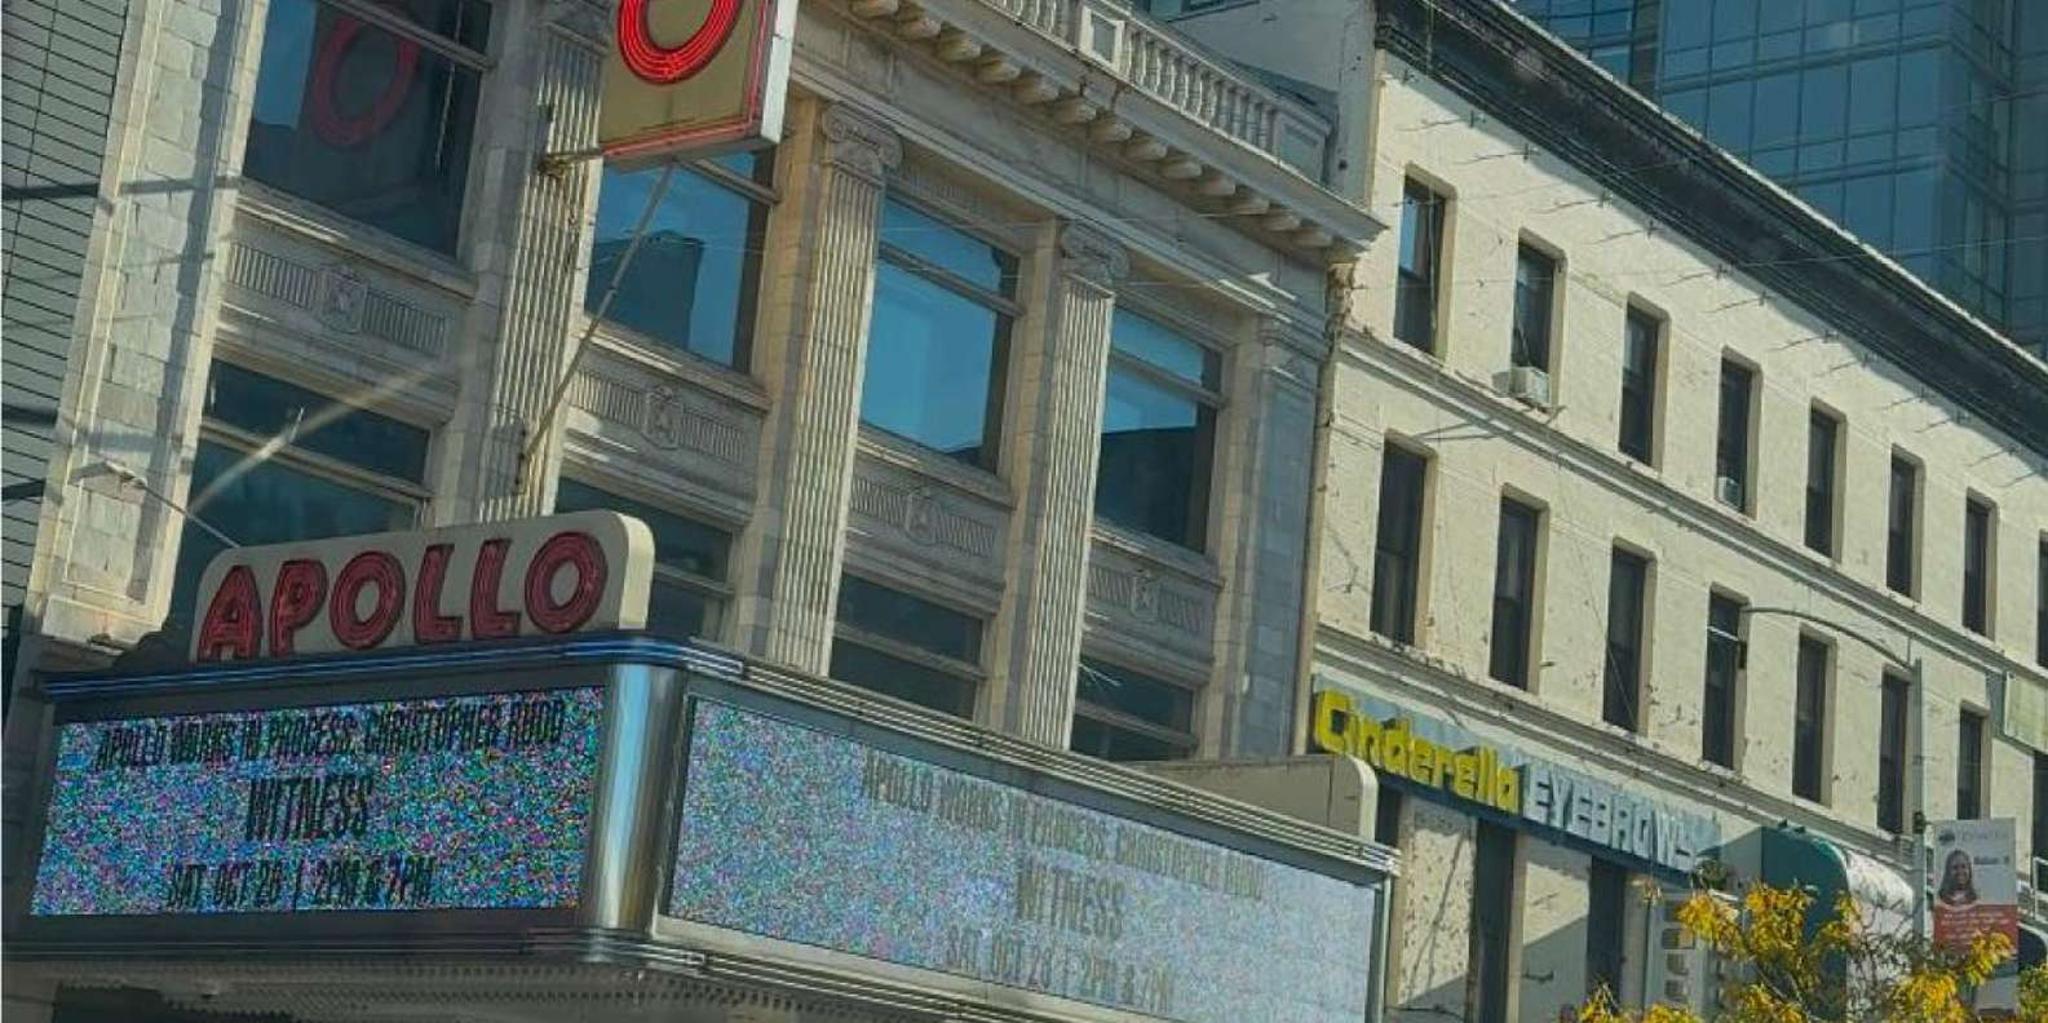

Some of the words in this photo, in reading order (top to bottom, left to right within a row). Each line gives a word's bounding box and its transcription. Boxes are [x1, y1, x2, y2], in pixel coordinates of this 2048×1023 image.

[197, 530, 608, 662] APOLLO
[95, 723, 167, 771] APOLLO
[170, 720, 236, 765] WORKS
[239, 717, 264, 761] IN
[363, 704, 504, 755] CHRISTOPHER
[1314, 688, 1520, 815] Cinderella
[245, 773, 374, 842] WITNESS
[860, 750, 933, 813] APOLLO
[937, 772, 1004, 832] WORKS
[1007, 791, 1030, 842] IN
[167, 864, 209, 907] SAT
[212, 862, 253, 907] OCT
[313, 858, 361, 907] 2PM
[384, 855, 436, 904] 7PM
[1015, 853, 1126, 941] WITNESS
[945, 924, 983, 971] SAT
[988, 932, 1025, 983] OCT
[1079, 950, 1118, 1000] 2PM
